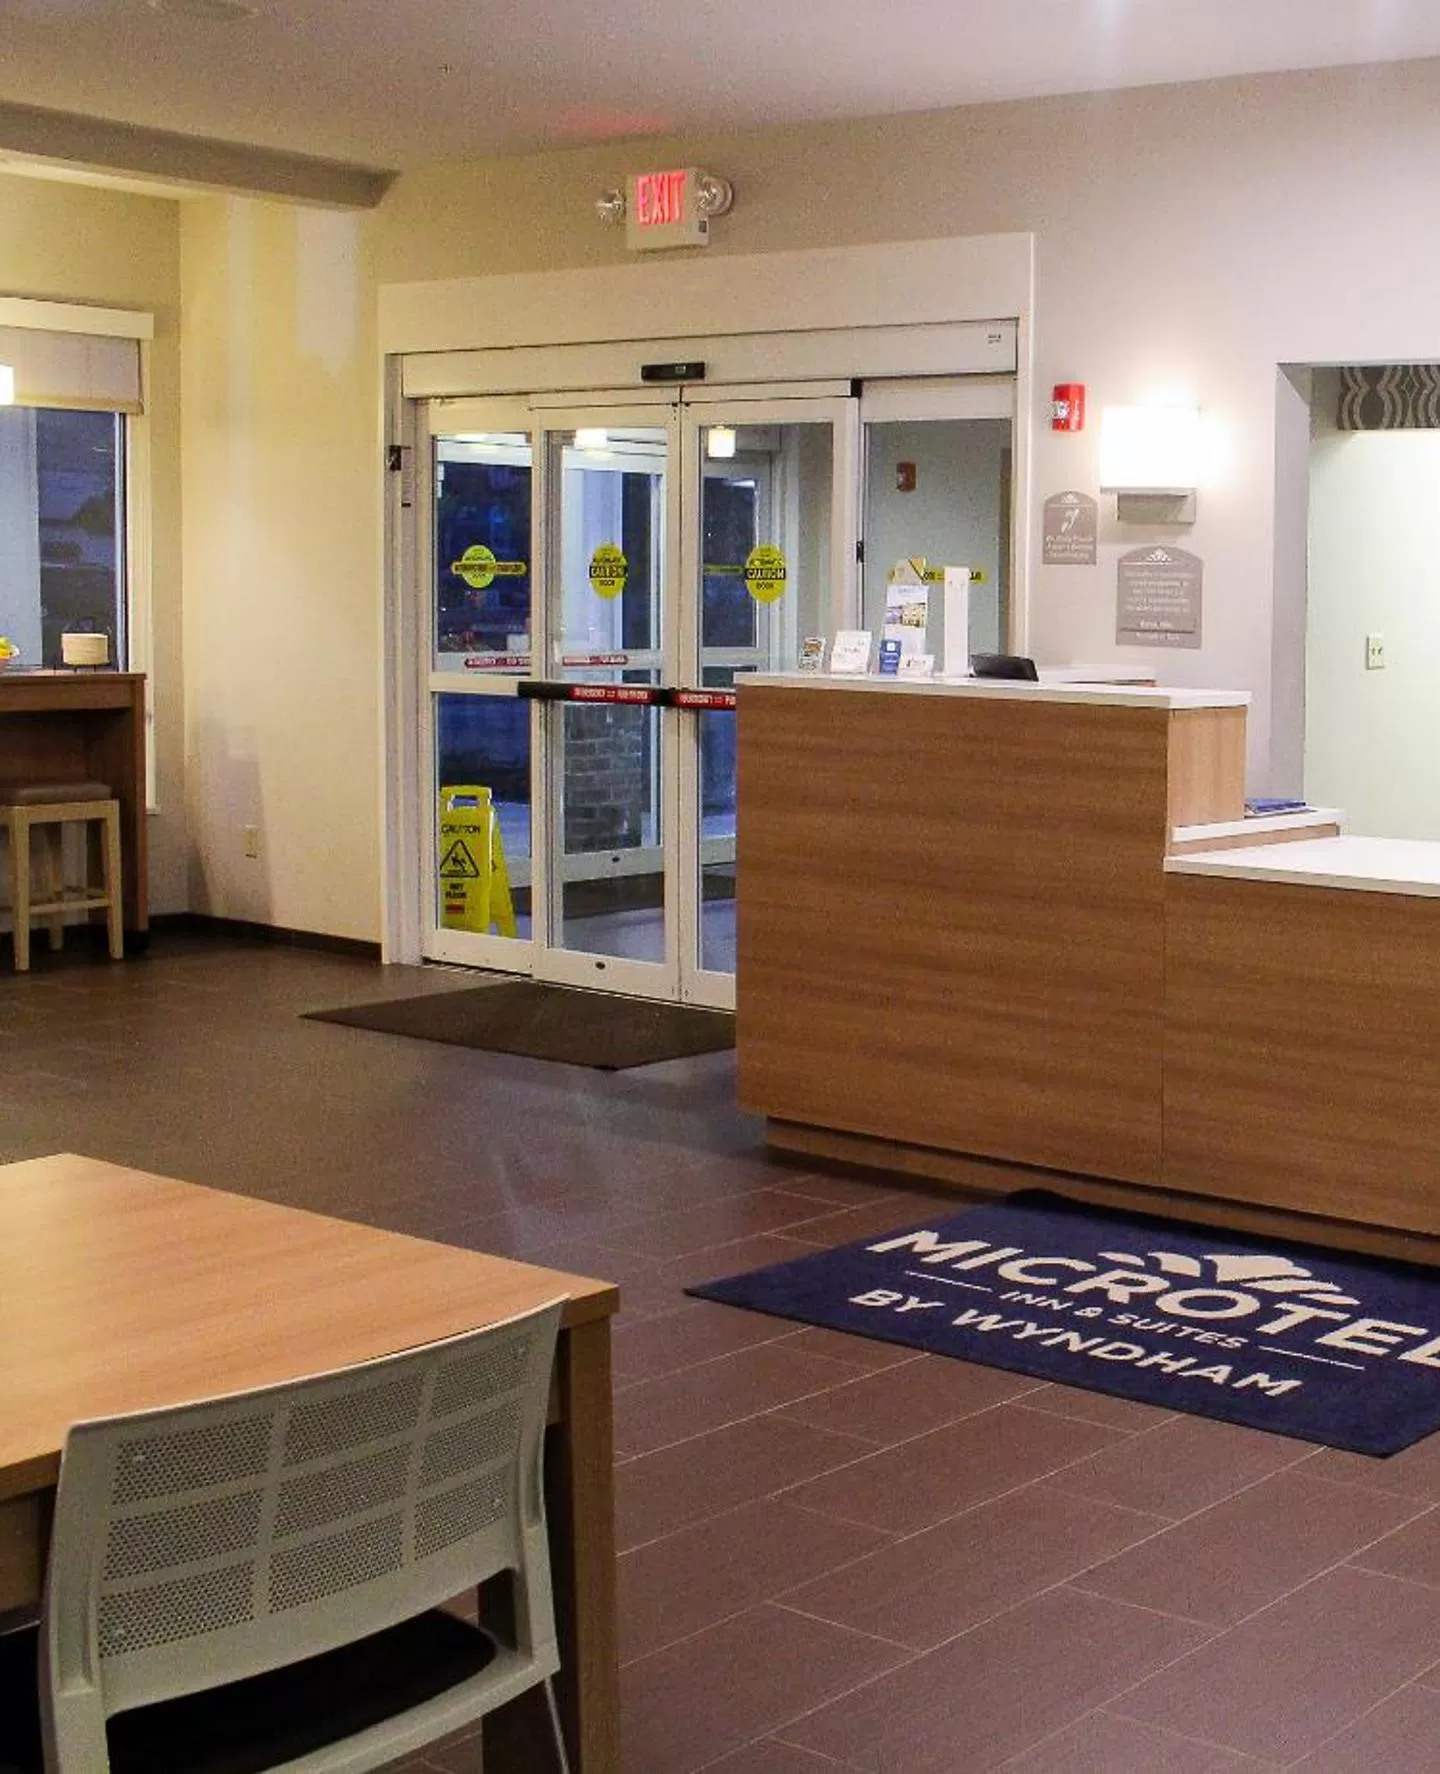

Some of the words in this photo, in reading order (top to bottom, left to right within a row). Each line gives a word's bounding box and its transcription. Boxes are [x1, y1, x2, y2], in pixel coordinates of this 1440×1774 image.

[637, 171, 686, 224] EXIT
[746, 569, 785, 580] CAUTION
[849, 1288, 945, 1312] BY
[952, 1308, 1303, 1397] WYNDHAM
[1000, 1291, 1074, 1311] INN
[1073, 1306, 1104, 1319] &
[1107, 1313, 1249, 1349] SUITES
